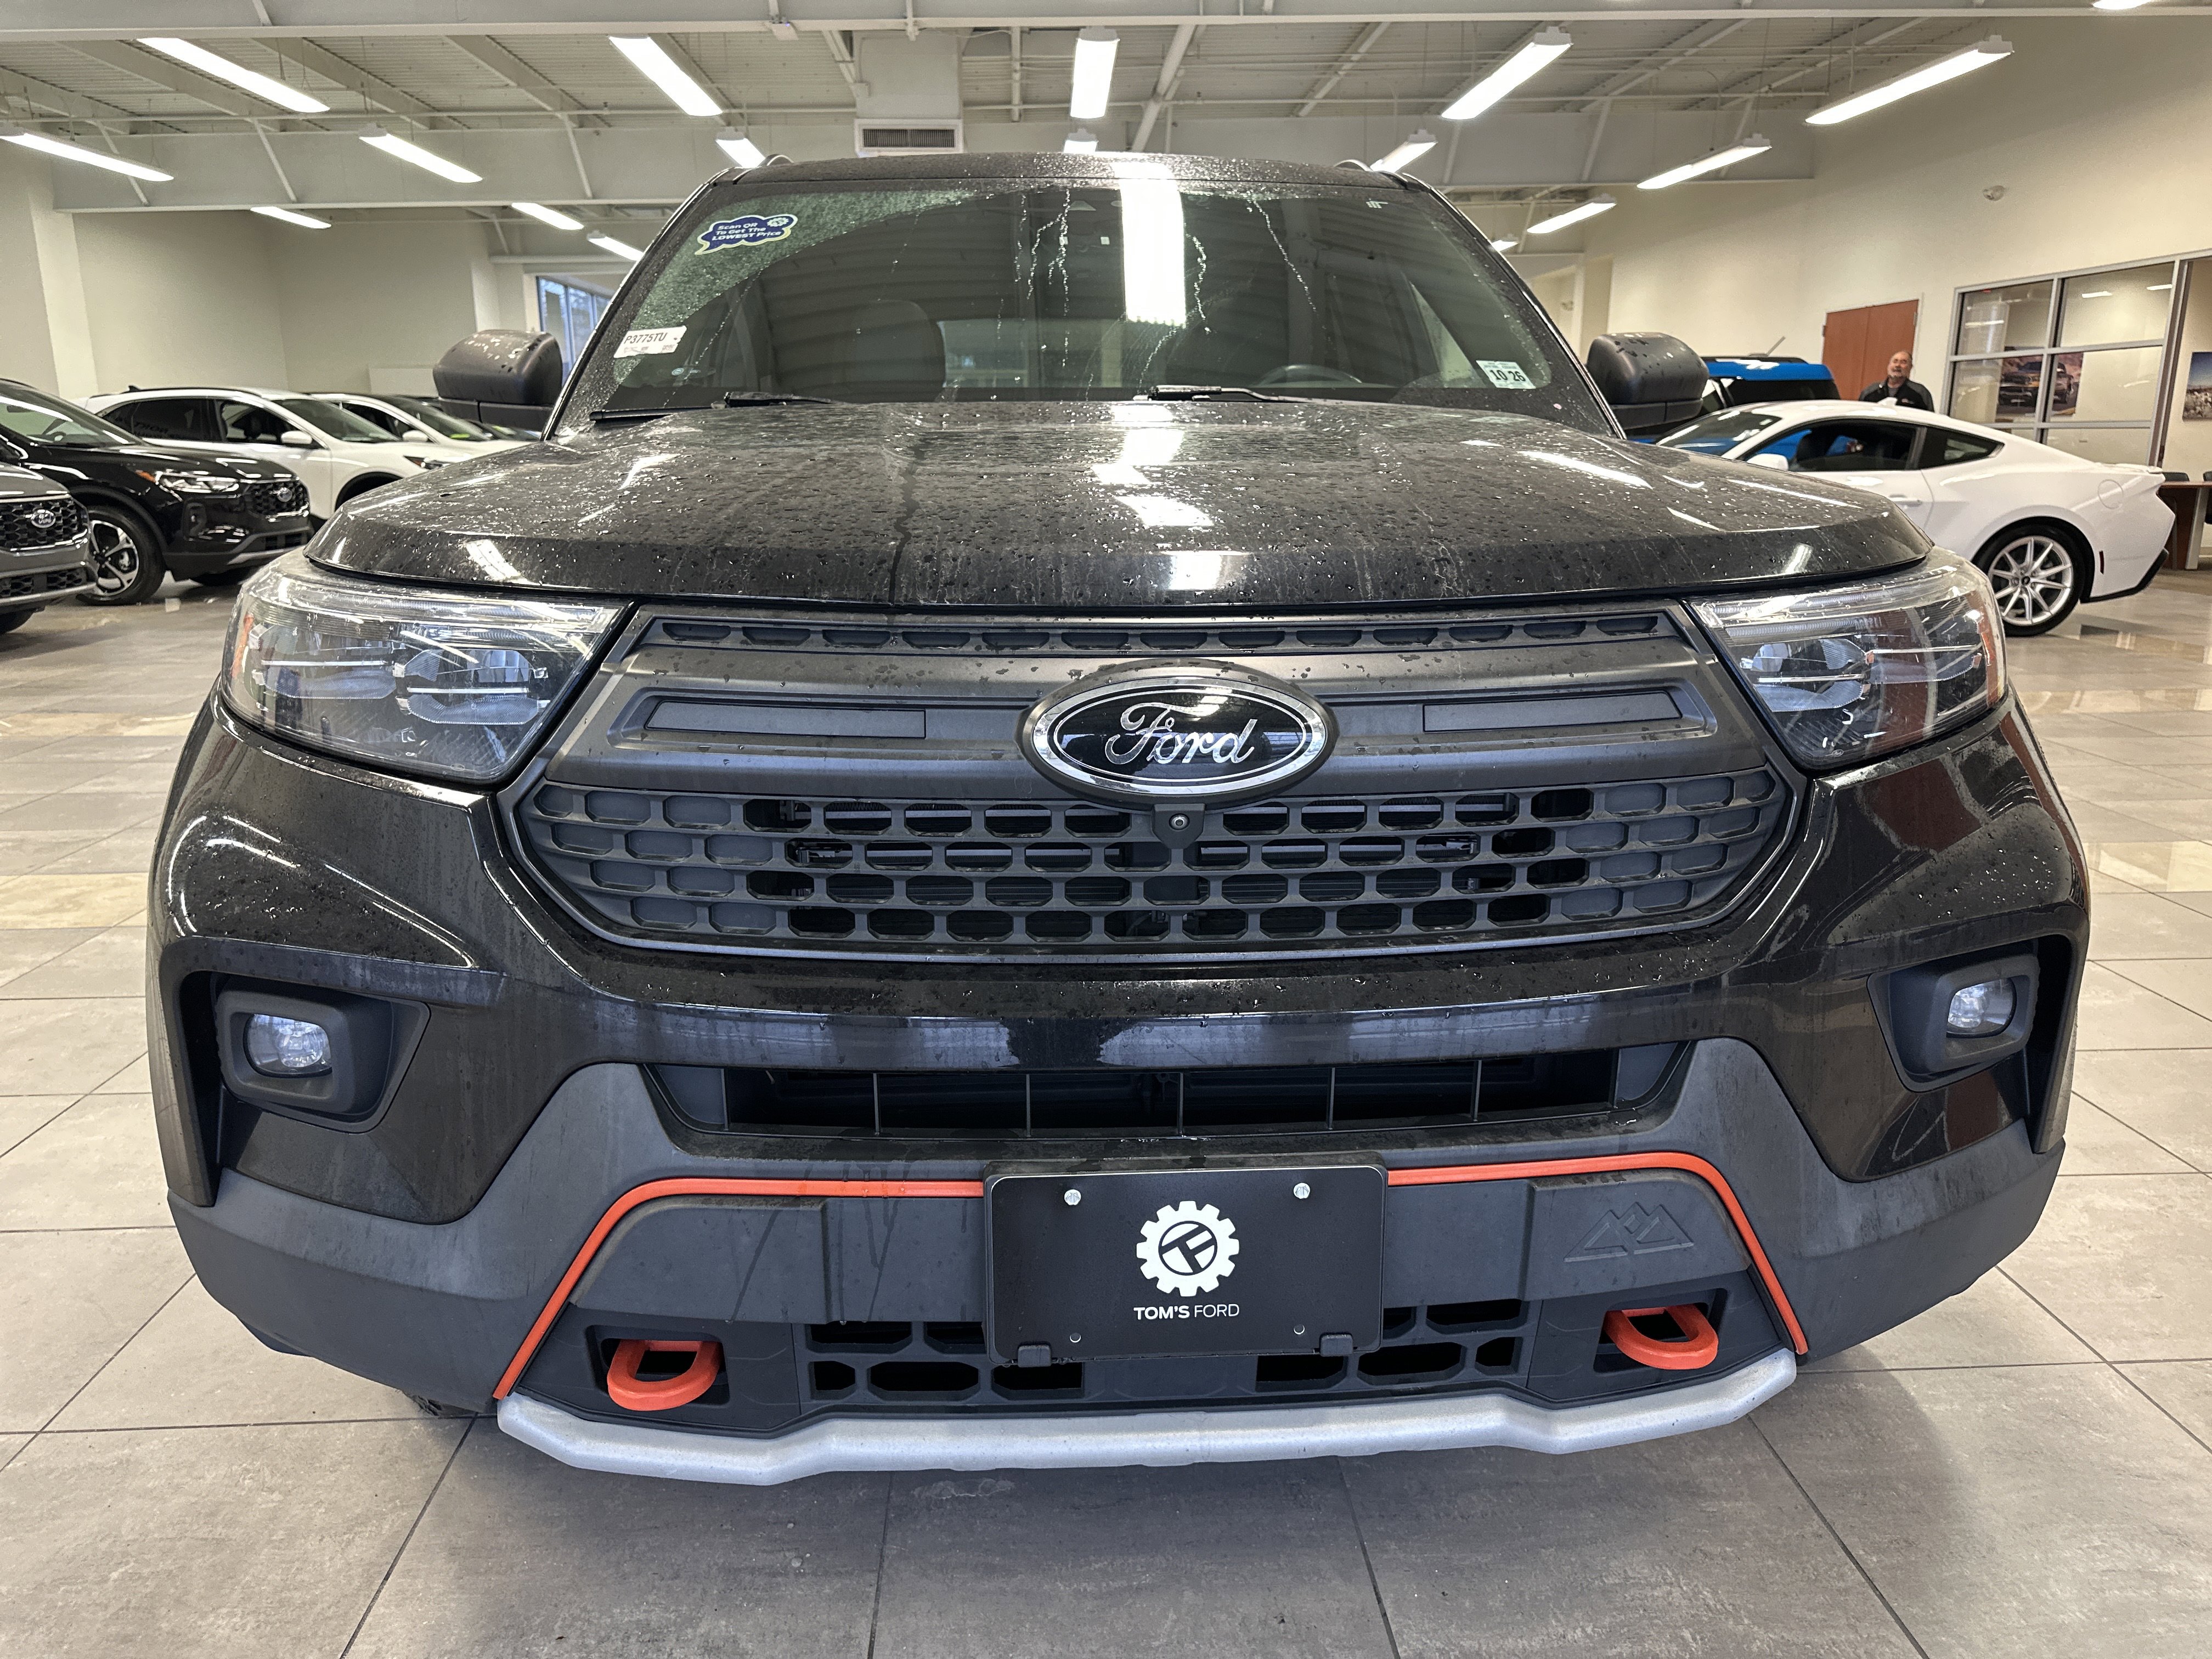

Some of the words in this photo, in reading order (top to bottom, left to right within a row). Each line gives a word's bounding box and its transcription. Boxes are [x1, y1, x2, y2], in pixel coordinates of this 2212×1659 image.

[712, 233, 756, 241] LOWEST
[623, 332, 668, 345] P3775TU
[1489, 370, 1508, 381] 10
[1508, 371, 1526, 382] 26
[1105, 702, 1258, 765] Ford
[1133, 1305, 1190, 1320] TOM'S
[1194, 1304, 1240, 1318] FORD
